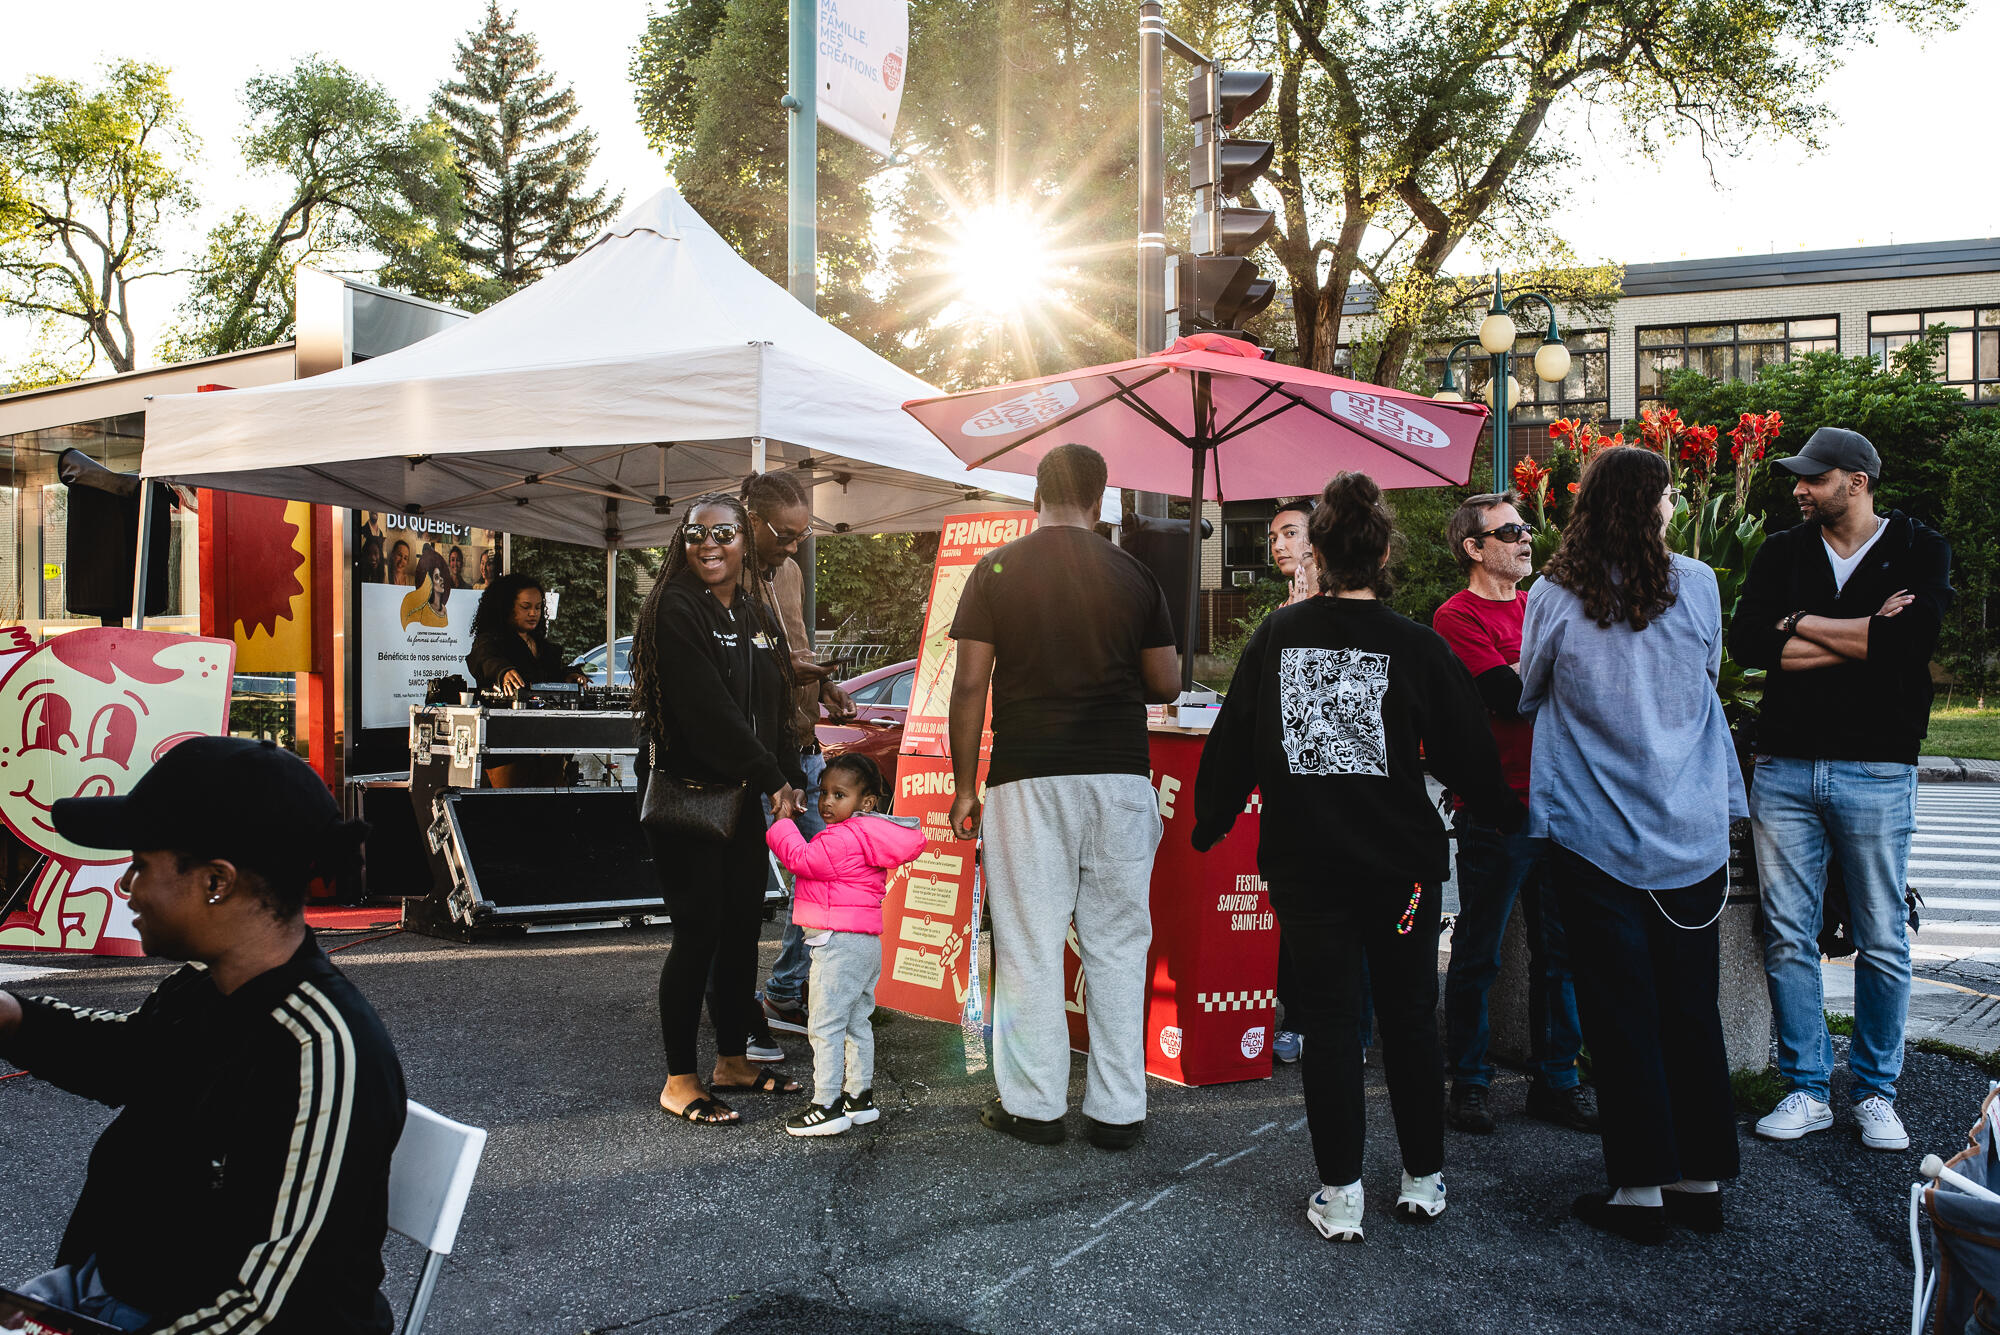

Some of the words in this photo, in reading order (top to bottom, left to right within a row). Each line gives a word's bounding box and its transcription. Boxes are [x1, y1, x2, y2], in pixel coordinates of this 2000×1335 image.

[821, 0, 838, 15] MA
[820, 11, 868, 48] FAMILLE,
[820, 25, 843, 48] MES
[387, 513, 407, 530] DU
[378, 651, 409, 661] Bénéficiez
[409, 653, 417, 661] de
[431, 653, 457, 661] services
[902, 772, 956, 799] FRING
[926, 811, 951, 827] COMME
[1235, 874, 1268, 892] FESTIVA
[1217, 894, 1259, 911] SAVEURS
[1231, 910, 1274, 931] SAINT-LÉO
[1161, 1037, 1181, 1048] TALON
[1242, 1039, 1263, 1048] TALON
[1244, 1032, 1264, 1040] JEAN-
[1168, 1046, 1180, 1055] EST
[1249, 1047, 1262, 1055] EST
